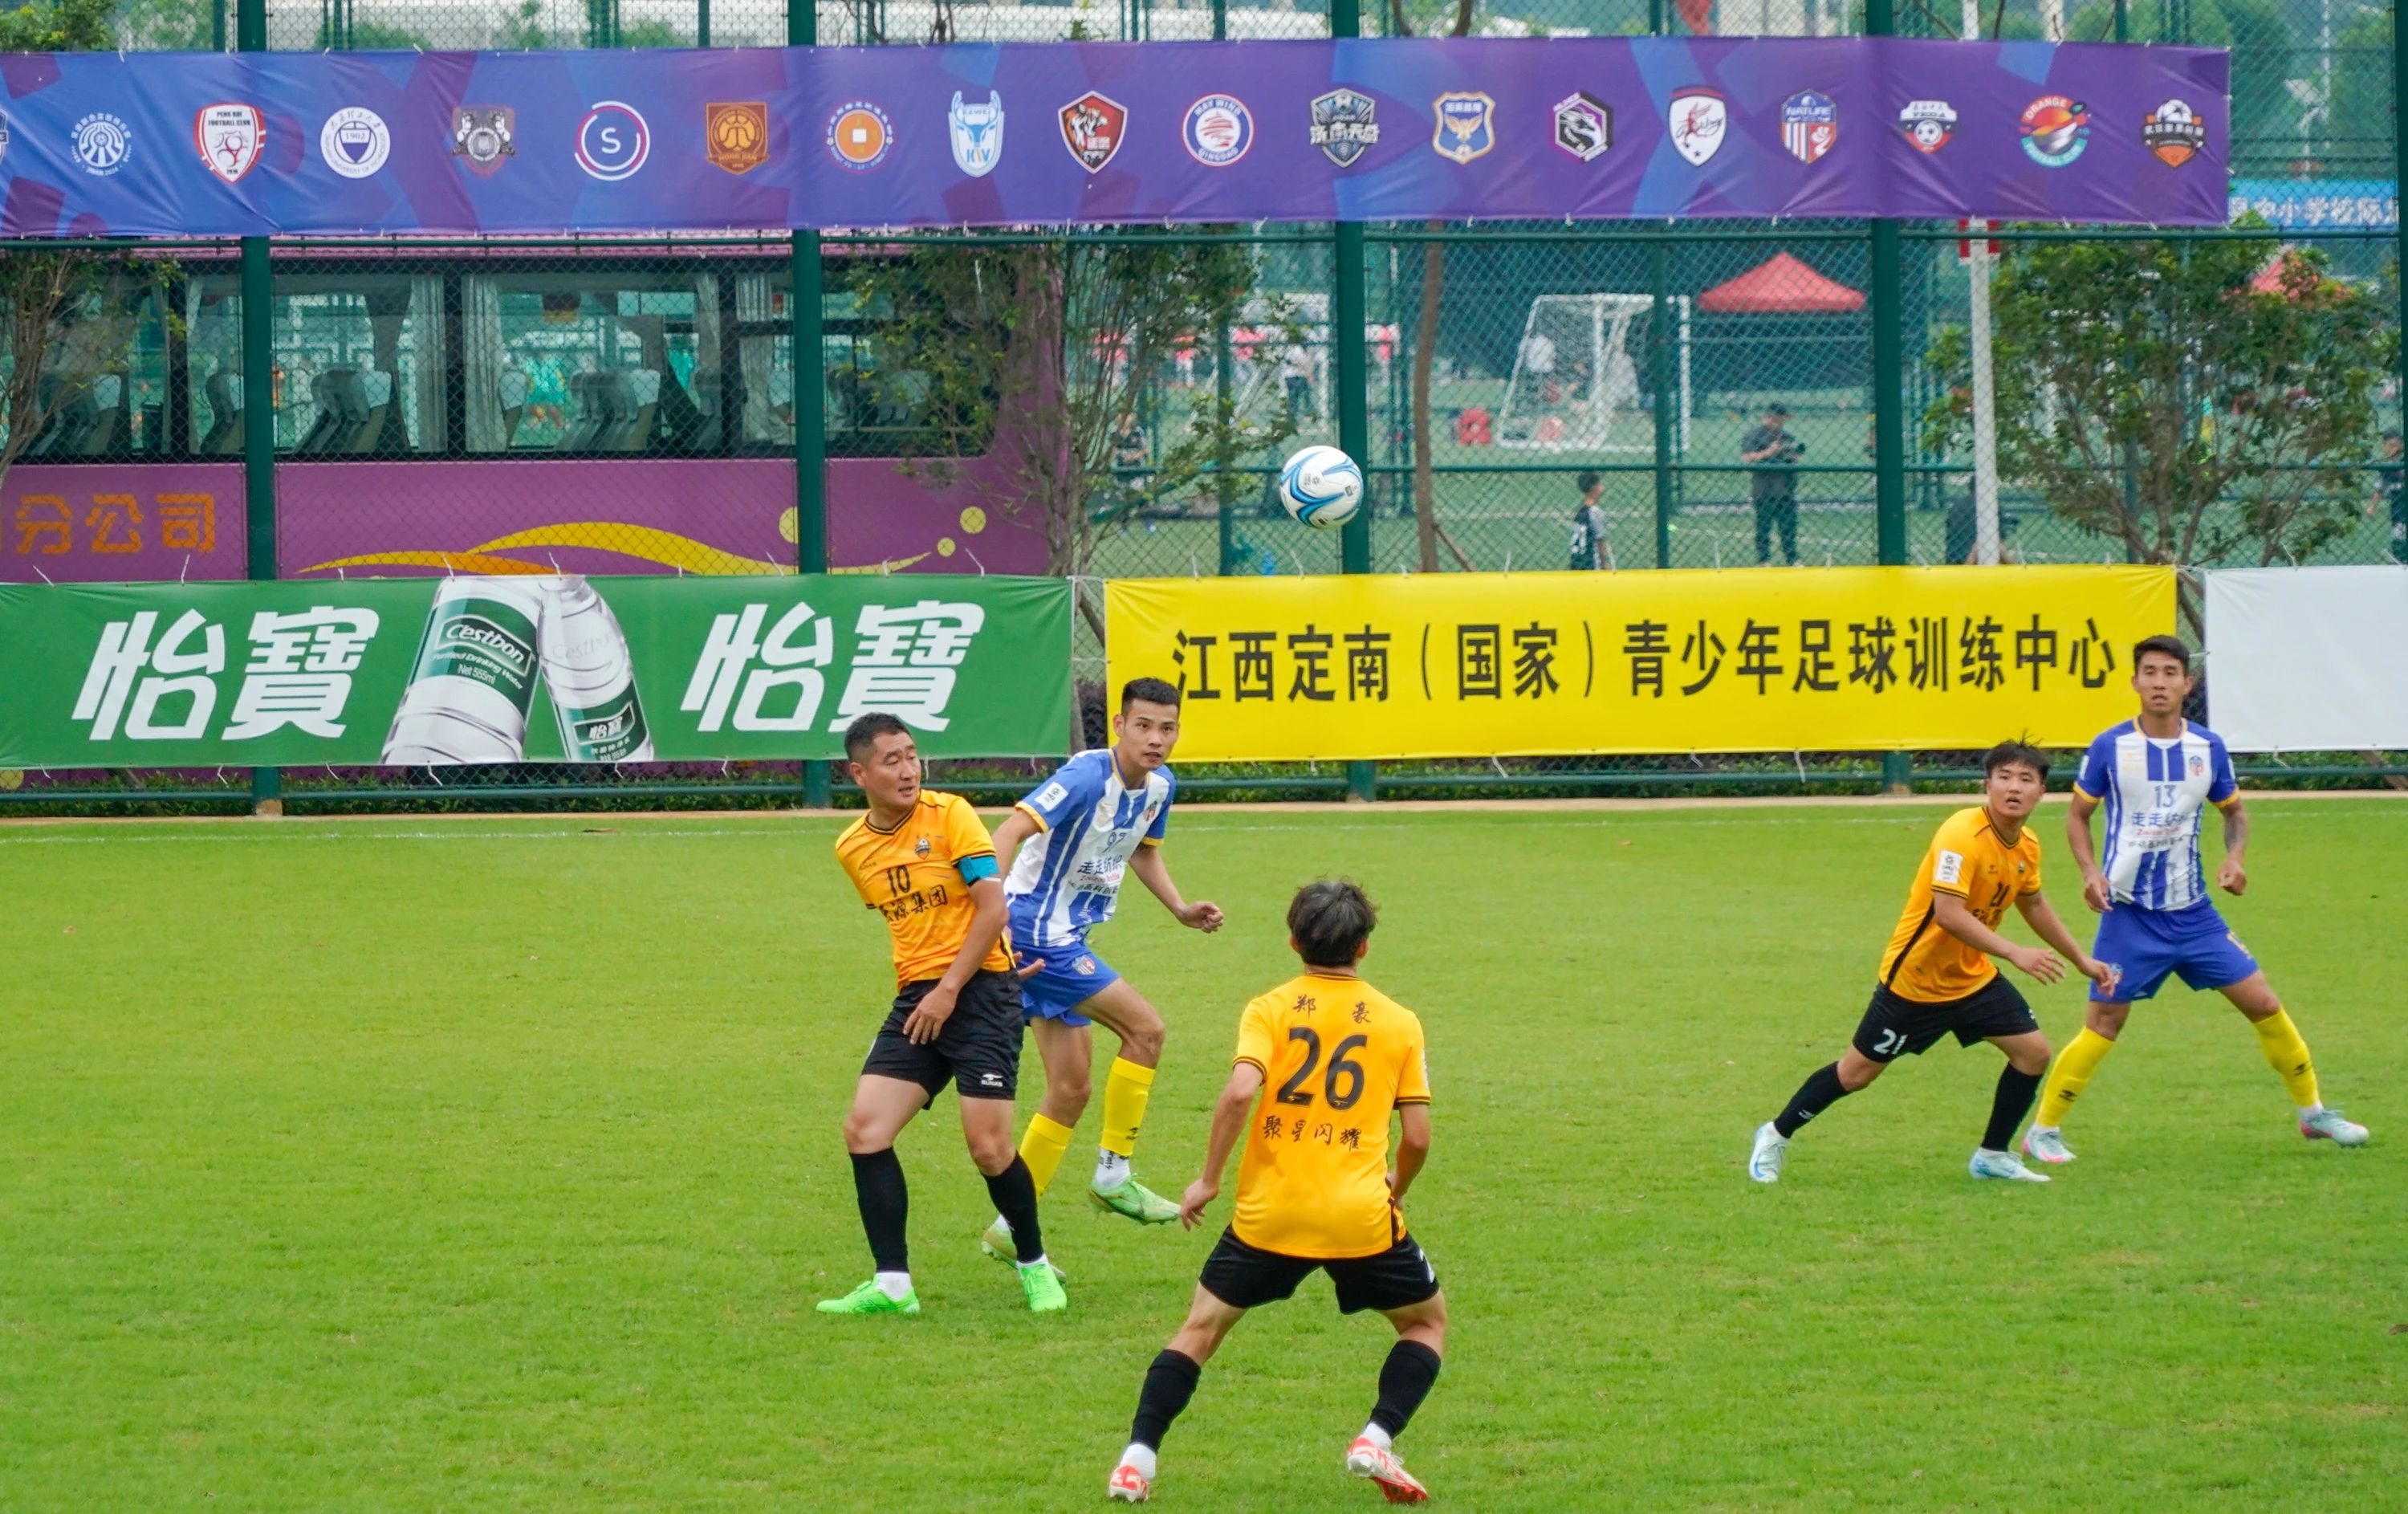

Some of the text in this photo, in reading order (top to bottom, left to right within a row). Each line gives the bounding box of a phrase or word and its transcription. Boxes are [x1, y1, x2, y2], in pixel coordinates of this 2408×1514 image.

[2025, 96, 2067, 120] ORANGE
[601, 127, 621, 154] S
[15, 494, 216, 554] 分公司
[458, 664, 473, 675] Net
[466, 653, 502, 674] Drinking
[2154, 784, 2176, 808] 13
[886, 865, 911, 897] 10
[1873, 1028, 1908, 1056] 21
[1277, 1027, 1368, 1111] 26
[1263, 1115, 1362, 1153] 聚星闪耀
